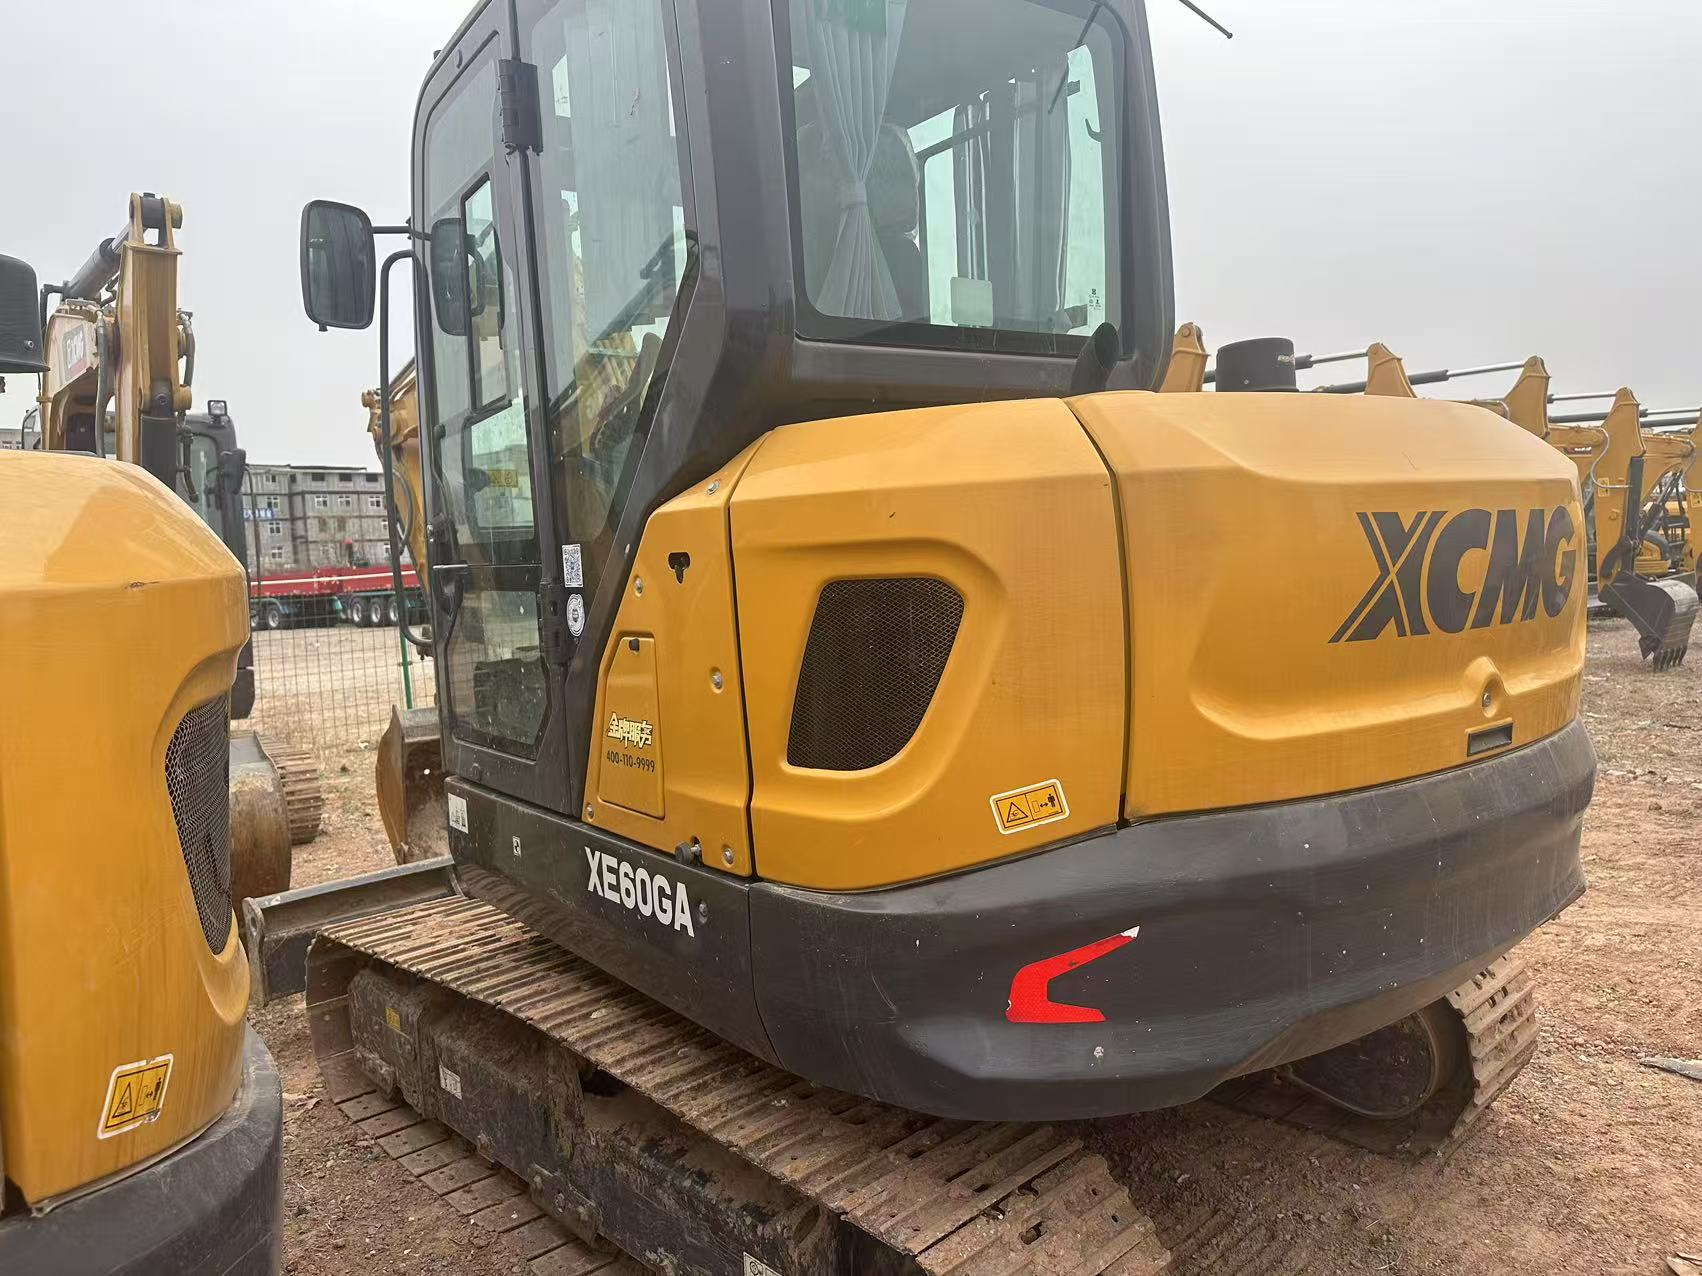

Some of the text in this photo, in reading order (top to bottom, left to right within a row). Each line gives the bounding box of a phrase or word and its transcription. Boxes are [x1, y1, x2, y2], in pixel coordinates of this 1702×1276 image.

[1328, 505, 1577, 644] XCMG
[607, 711, 653, 749] 金牌服务
[607, 750, 655, 773] 400-110-9999
[584, 846, 695, 938] XE60GA
